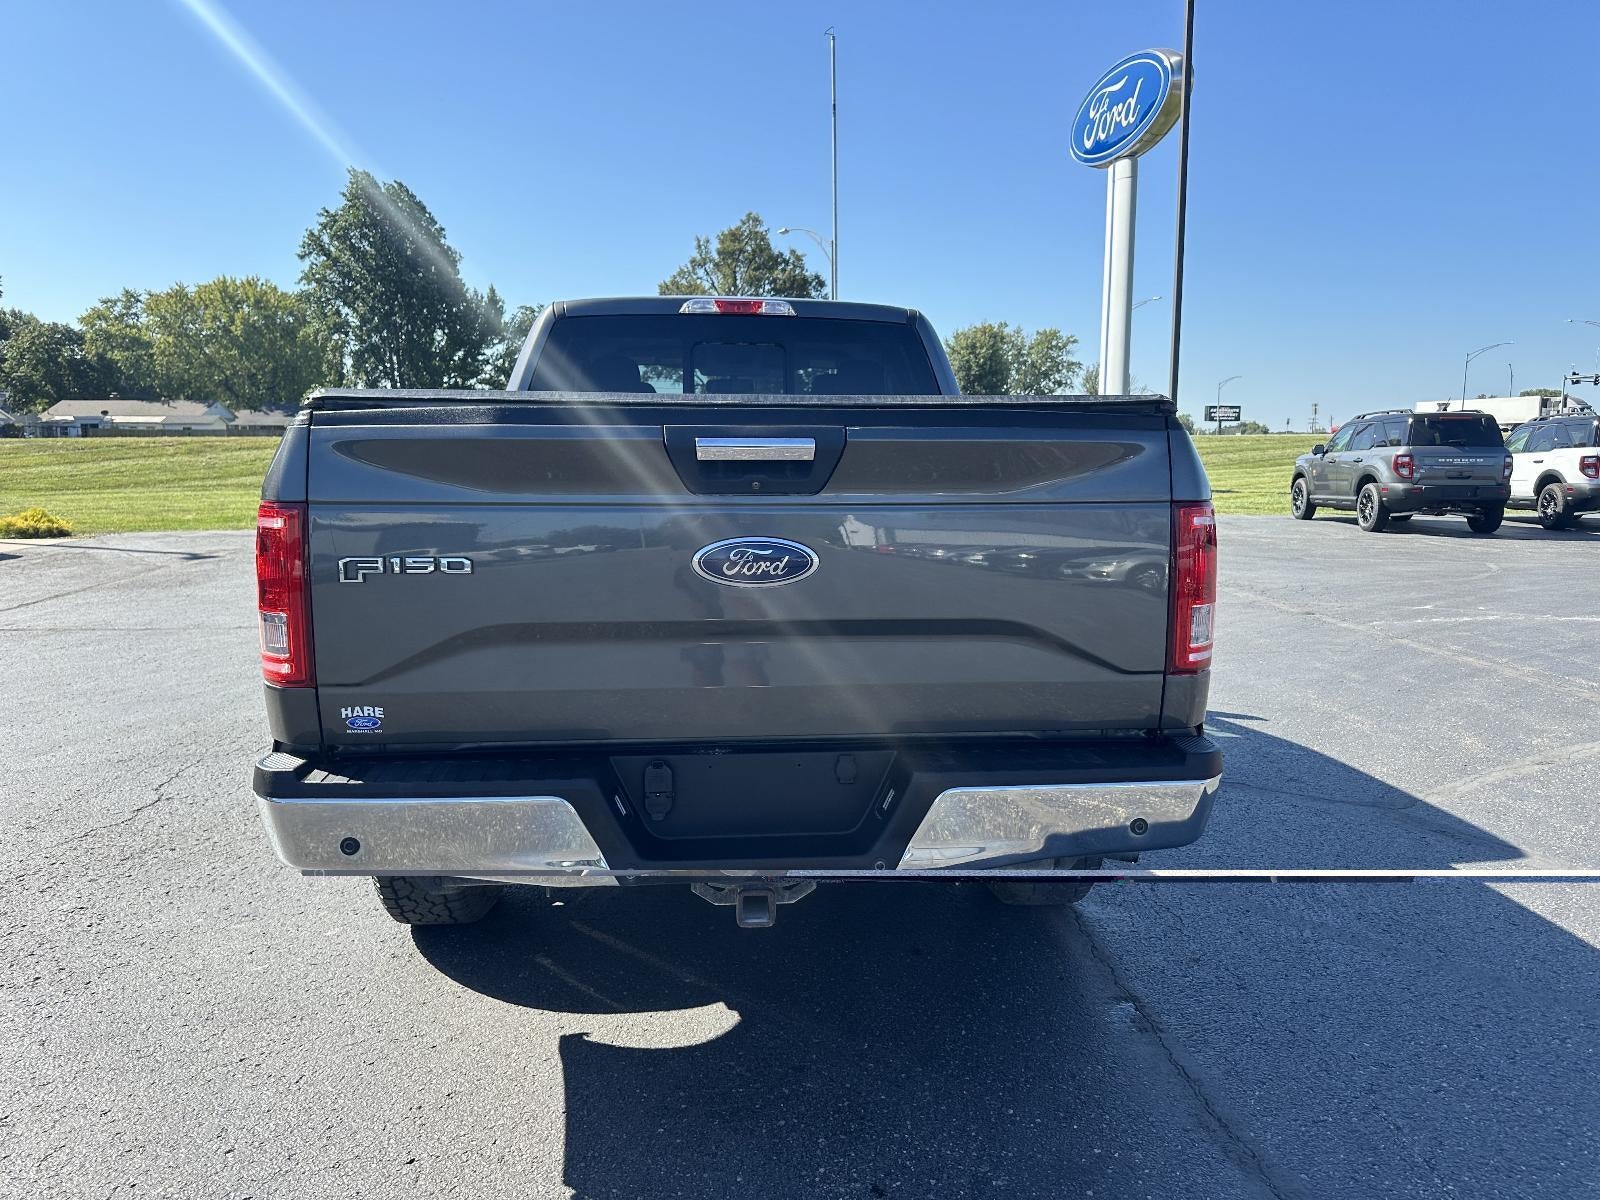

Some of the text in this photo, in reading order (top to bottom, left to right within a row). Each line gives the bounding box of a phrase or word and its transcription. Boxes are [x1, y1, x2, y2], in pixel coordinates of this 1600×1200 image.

[1083, 75, 1144, 149] Ford
[722, 548, 789, 576] Ford
[341, 706, 384, 718] HARE
[354, 719, 373, 727] Ford
